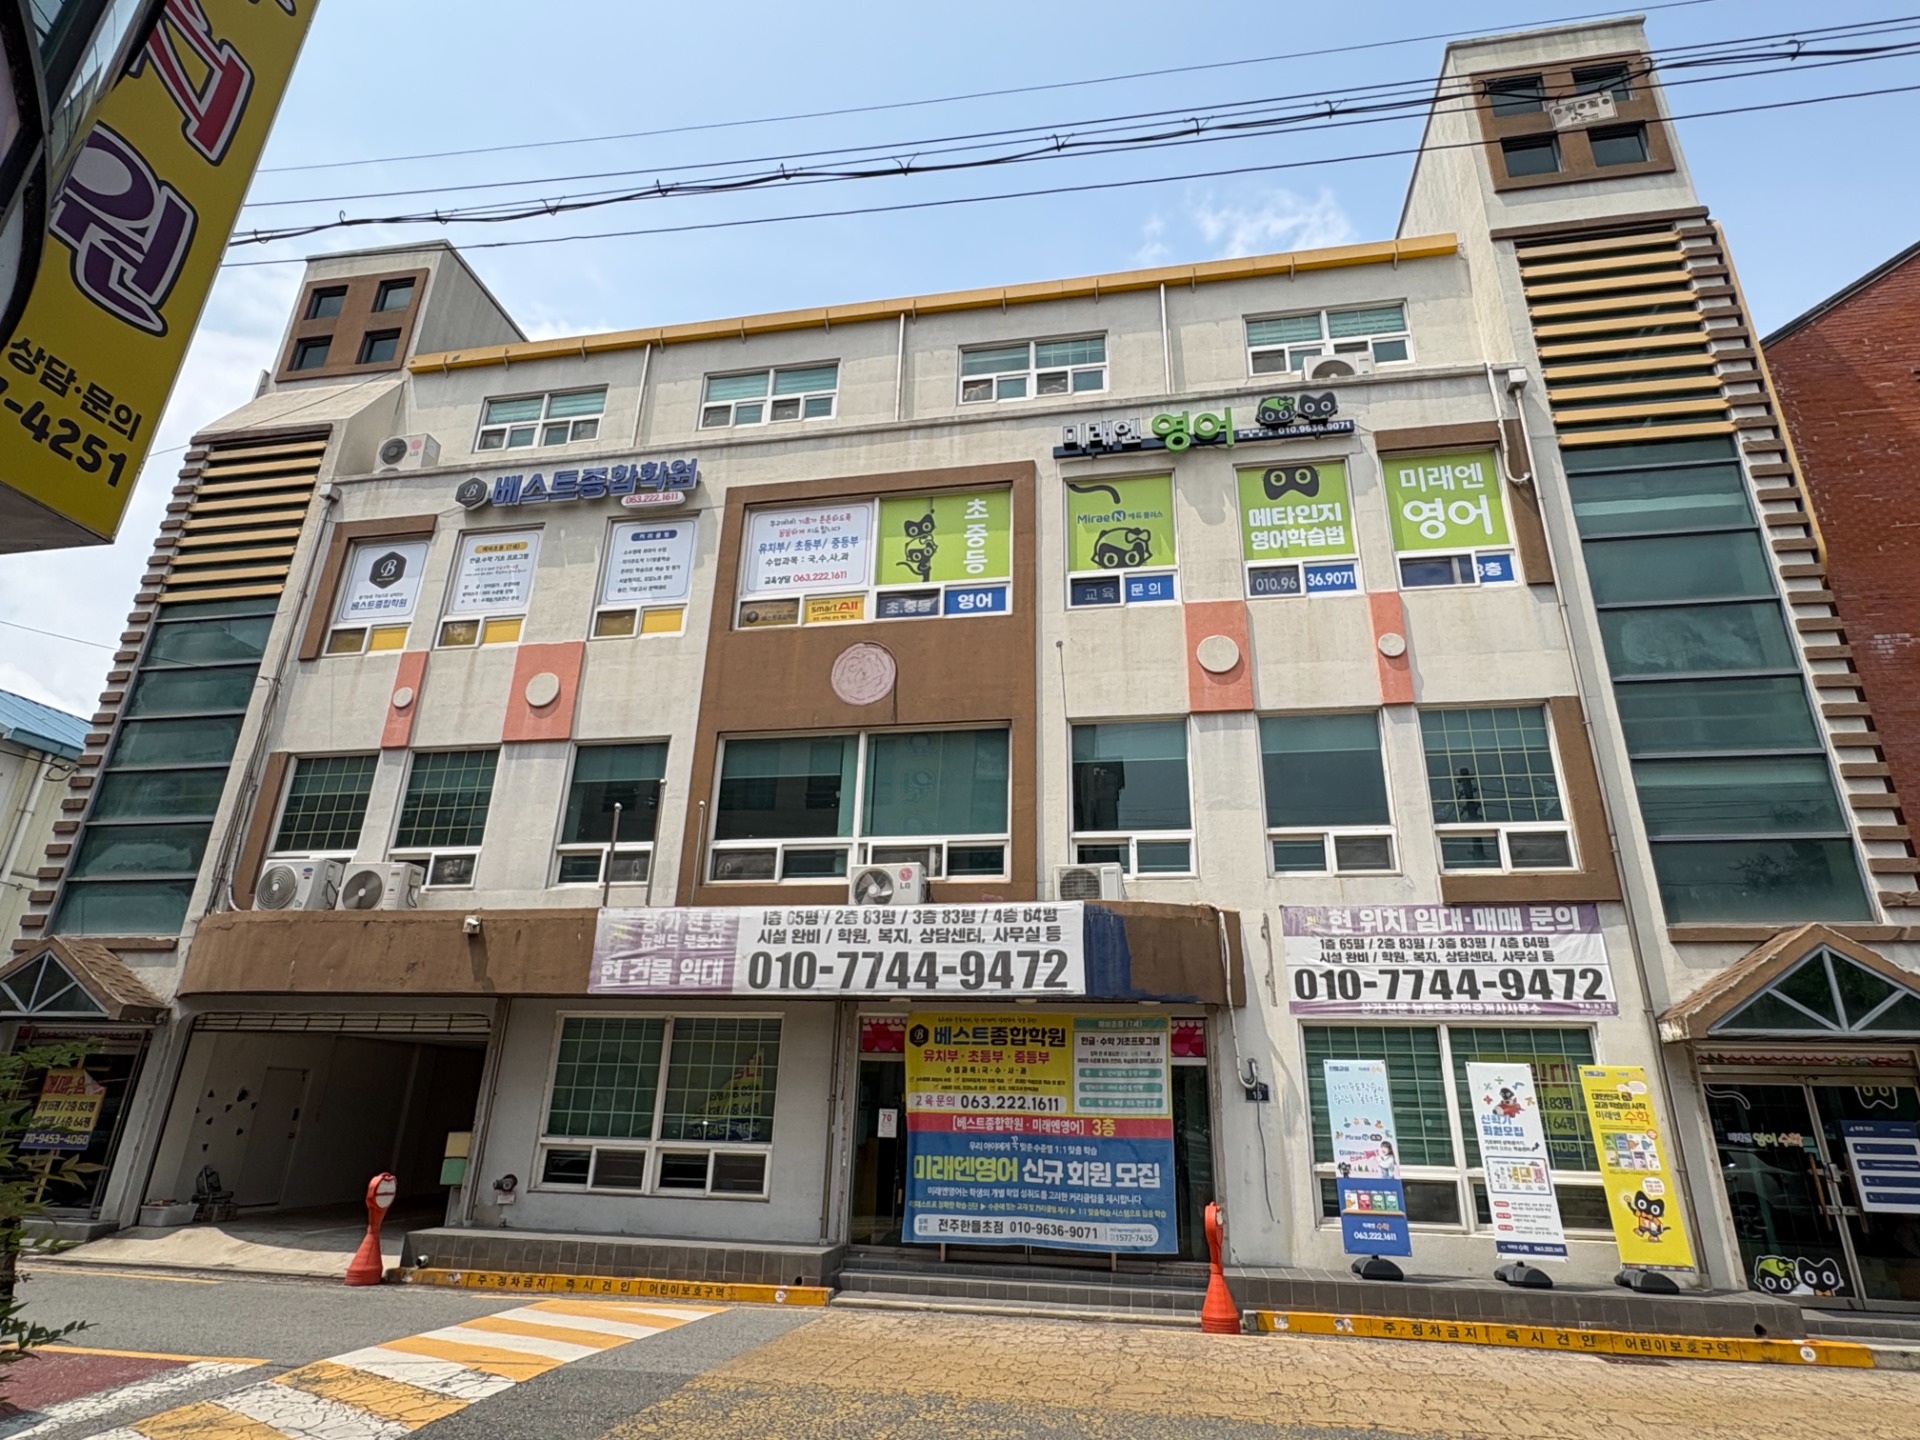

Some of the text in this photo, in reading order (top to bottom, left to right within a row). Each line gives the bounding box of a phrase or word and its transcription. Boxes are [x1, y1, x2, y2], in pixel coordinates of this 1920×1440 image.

[7, 337, 142, 442] 상담·문의
[0, 376, 127, 487] -4251
[1063, 418, 1141, 450] 미래엔
[1151, 407, 1234, 451] 영어
[491, 458, 698, 506] 베스트종합학원
[1399, 462, 1484, 493] 미래엔
[1249, 503, 1342, 527] 메타인지
[1404, 495, 1493, 539] 영어
[794, 538, 828, 552] 초등부/
[831, 536, 859, 549] 중등부
[1251, 526, 1345, 550] 영어학습법
[765, 556, 798, 567] 수업과목
[793, 571, 847, 583] 063.222.1611
[1085, 583, 1161, 600] 교육 문의
[958, 593, 992, 610] 영어
[763, 911, 781, 926] 1층
[835, 911, 859, 925] 2층
[863, 910, 896, 924] 83평
[913, 910, 937, 924] 3층
[942, 909, 976, 924] 83평
[993, 909, 1018, 923] 4층
[1023, 908, 1058, 923] 64평
[1328, 908, 1352, 933] 현
[1359, 908, 1407, 933] 위치
[1529, 906, 1581, 931] 문의
[684, 933, 723, 949] 부동산
[757, 925, 1062, 944] 시설 완비 학원, 복지, 상담센터, 사무실 등
[1320, 936, 1550, 950] 1층 65평 2층 83평 3층 83평 4층 64평
[1320, 952, 1342, 963] 시설
[1346, 952, 1369, 963] 완비
[1413, 951, 1441, 963] 복지,
[1445, 951, 1498, 963] 상담센터,
[1503, 951, 1539, 962] 사무실
[1543, 951, 1555, 962] 등
[601, 957, 724, 986] 현 건물 임대
[748, 950, 1068, 990] 010-7744-9472
[1294, 968, 1607, 1001] 010-7744-9472
[934, 1026, 1066, 1048] 베스트종합학원
[923, 1049, 1050, 1065] 유치부 초등부 중등부
[960, 1095, 1059, 1111] 063.222.1611
[1595, 1110, 1650, 1125] 미래엔 수학
[1092, 1118, 1116, 1137] 3층
[969, 1141, 983, 1151] 우리
[1083, 1146, 1098, 1156] 학습
[1752, 1132, 1779, 1148] 영어
[913, 1154, 1161, 1189] 미래엔영어 신규 회원 모집
[938, 1218, 1004, 1234] 전주한들초점
[1009, 1221, 1098, 1239] 010-9636-9071
[649, 1283, 725, 1298] 어린이보호구역
[1624, 1337, 1732, 1354] 어린이보호구역
